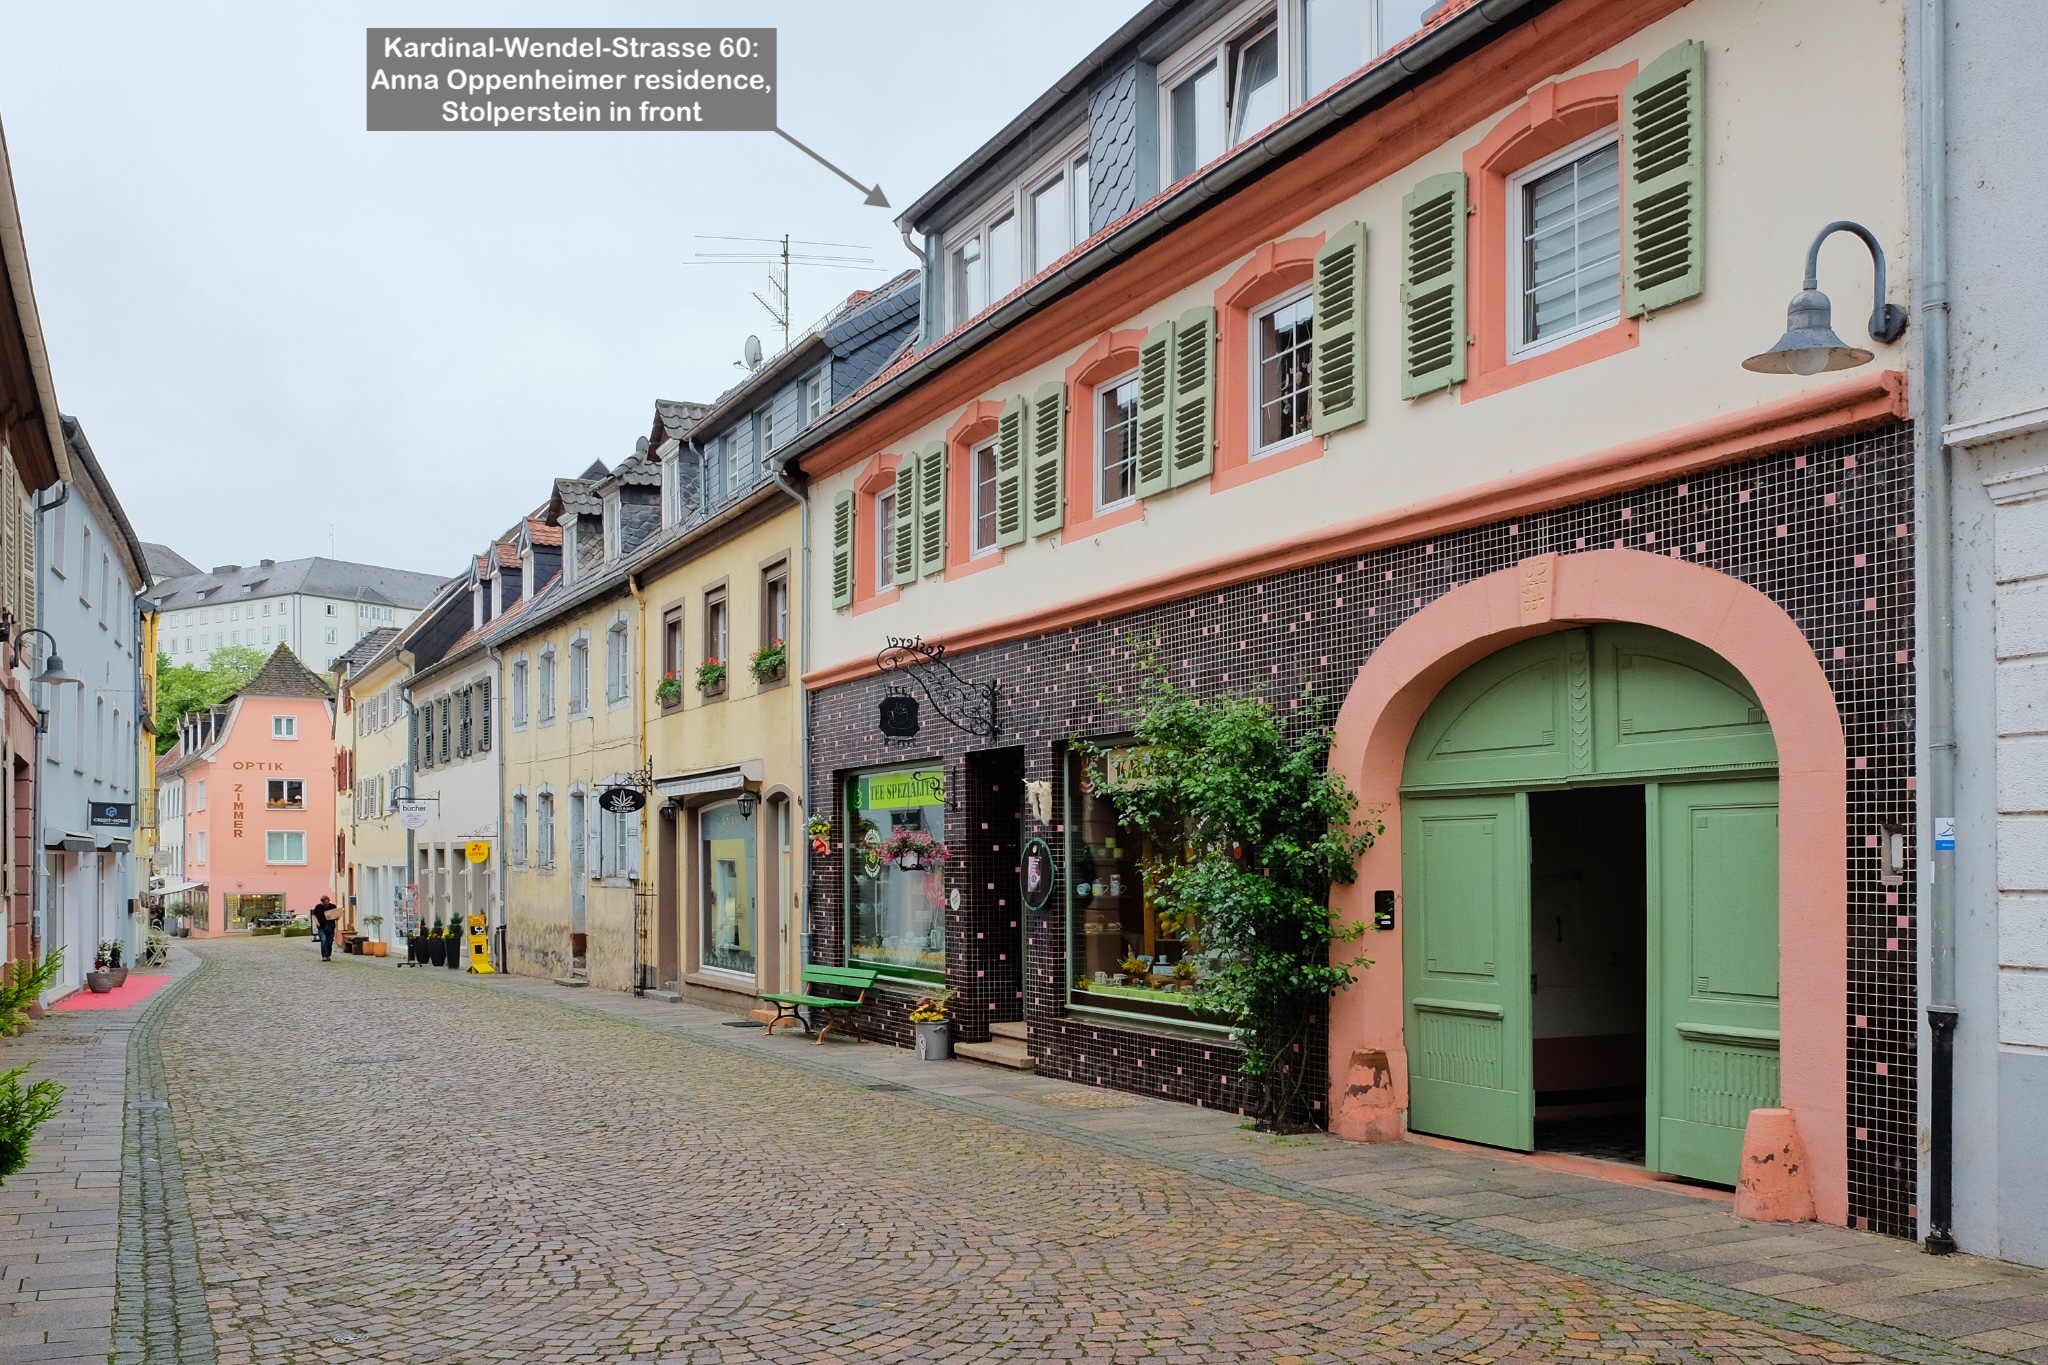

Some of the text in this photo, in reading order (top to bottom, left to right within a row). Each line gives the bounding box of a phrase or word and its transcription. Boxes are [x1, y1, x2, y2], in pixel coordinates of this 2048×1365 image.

[233, 761, 284, 771] OPTIK
[870, 779, 944, 801] TEE SPEZIALIT
[233, 783, 244, 838] ZIMMER
